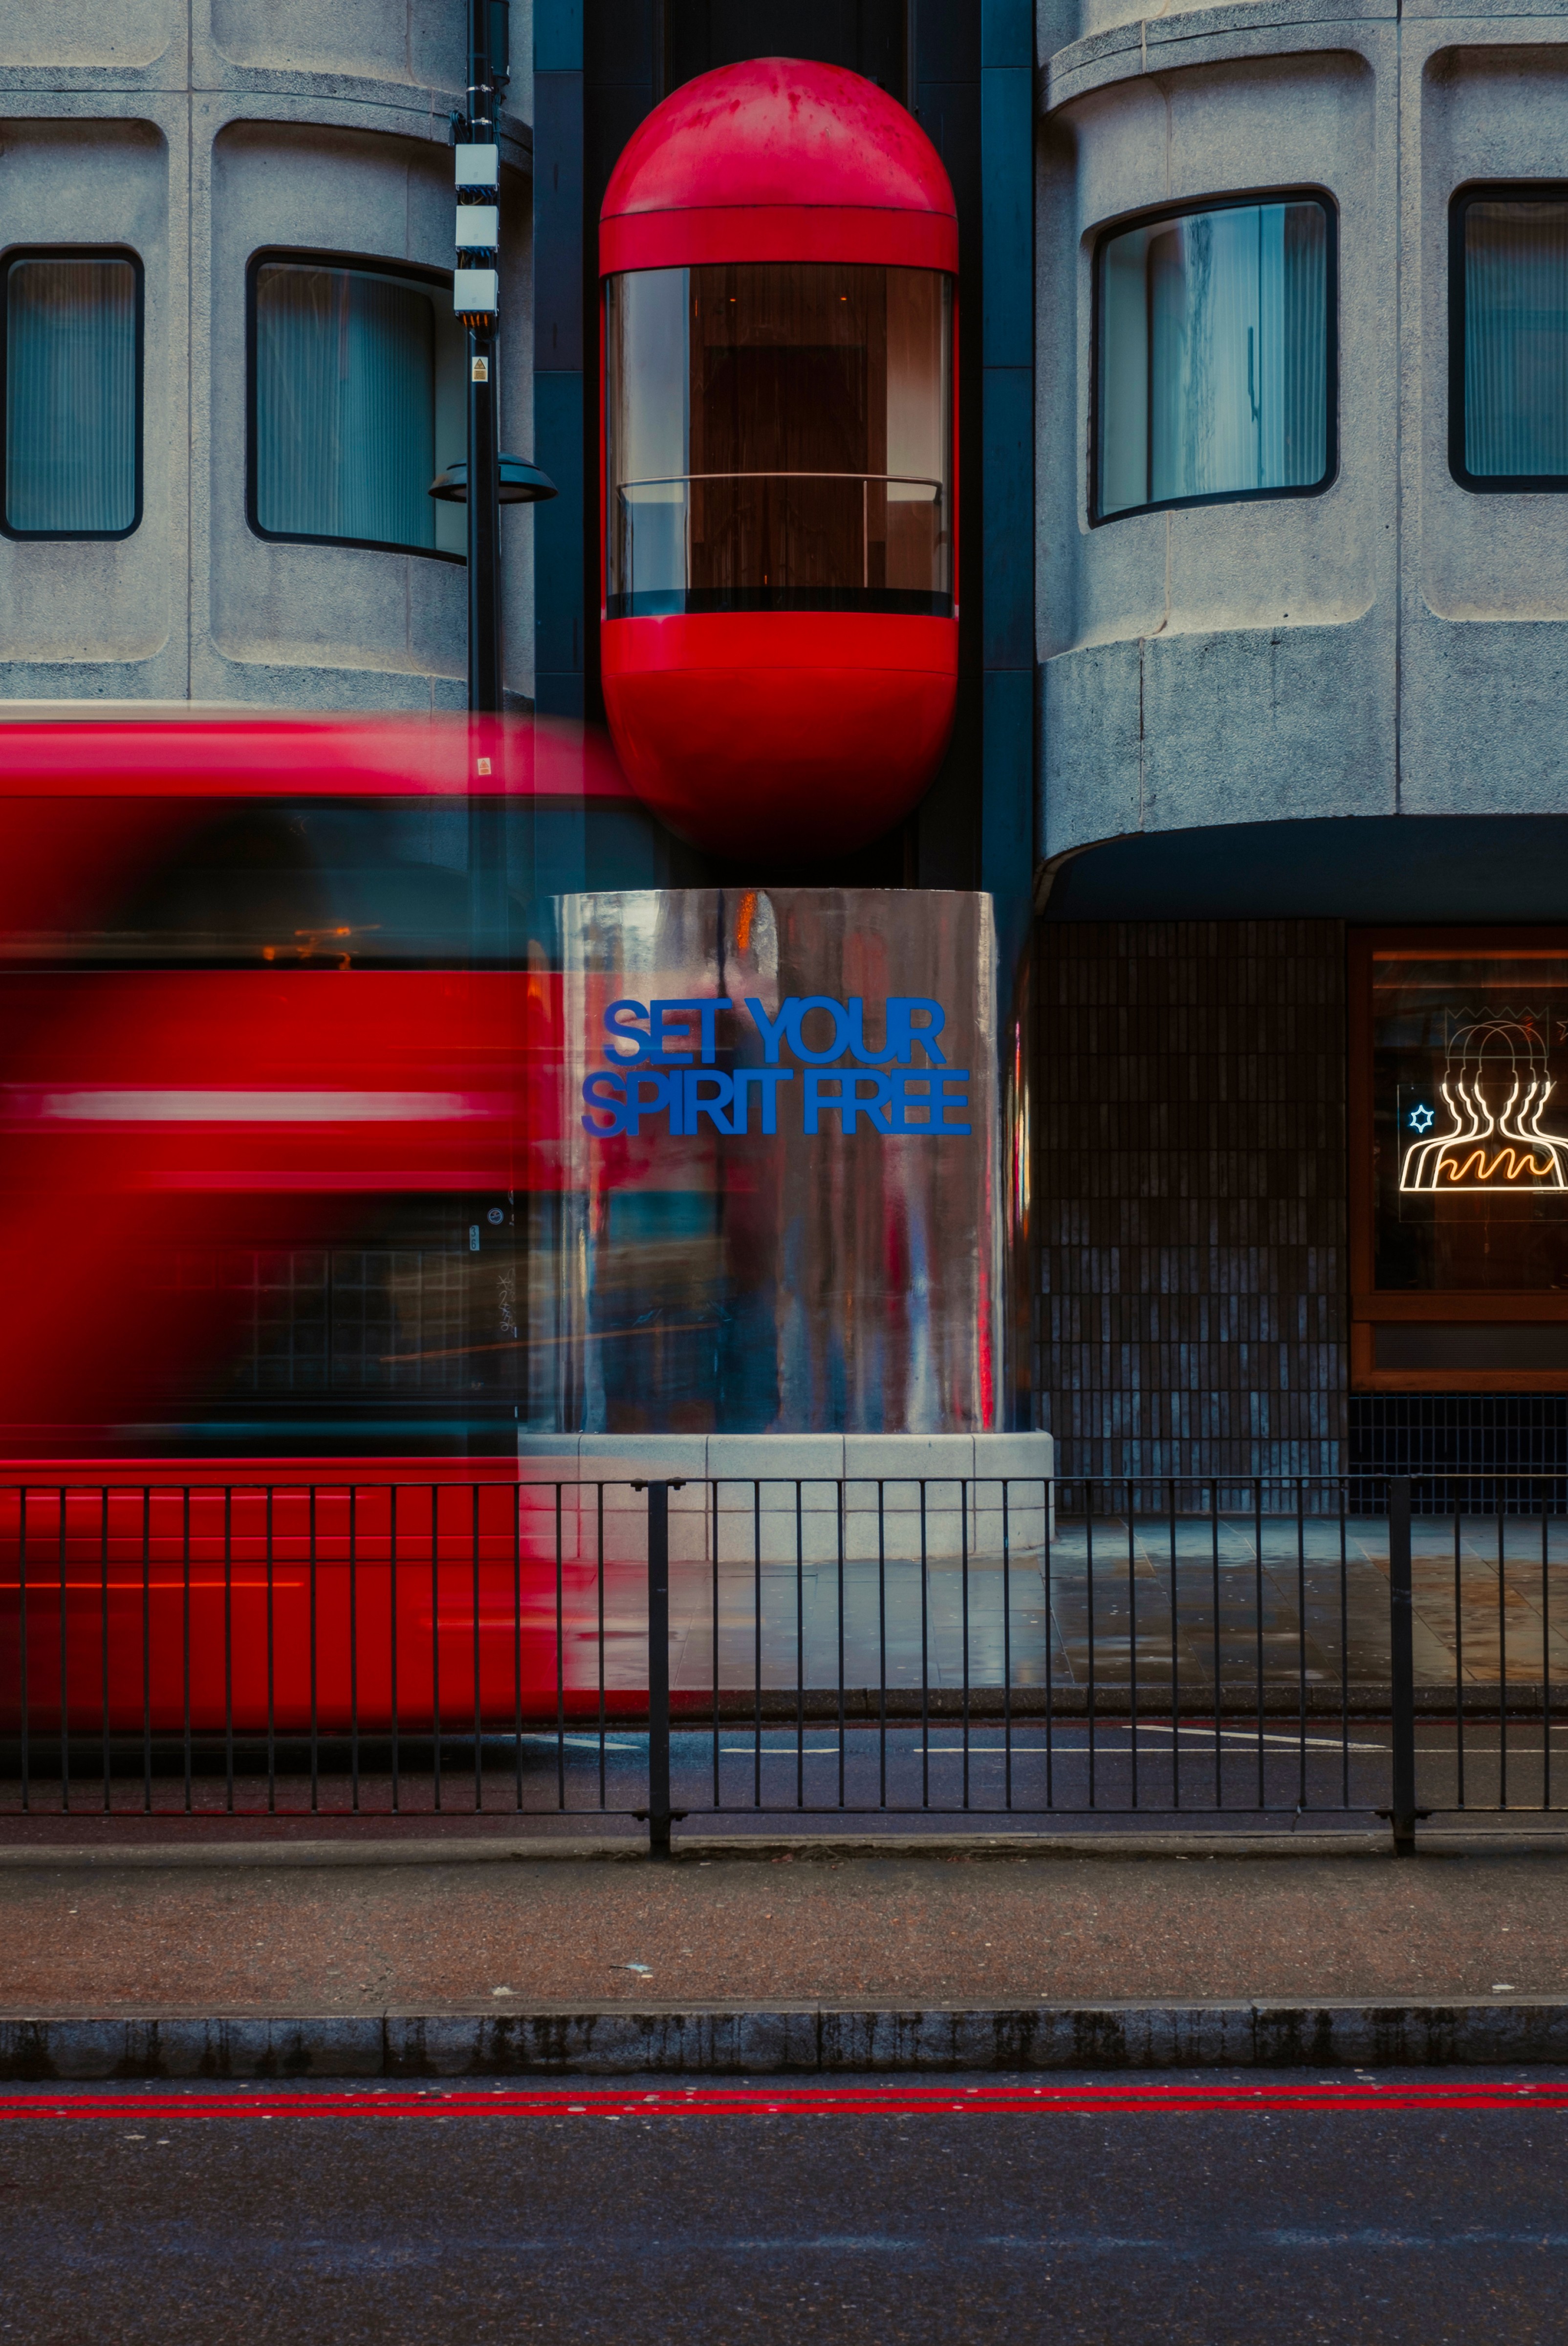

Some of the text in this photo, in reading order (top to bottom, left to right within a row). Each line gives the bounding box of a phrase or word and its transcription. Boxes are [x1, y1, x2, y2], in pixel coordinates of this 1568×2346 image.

[603, 995, 947, 1066] SET YOUR
[581, 1068, 972, 1138] SPIRIT FREE
